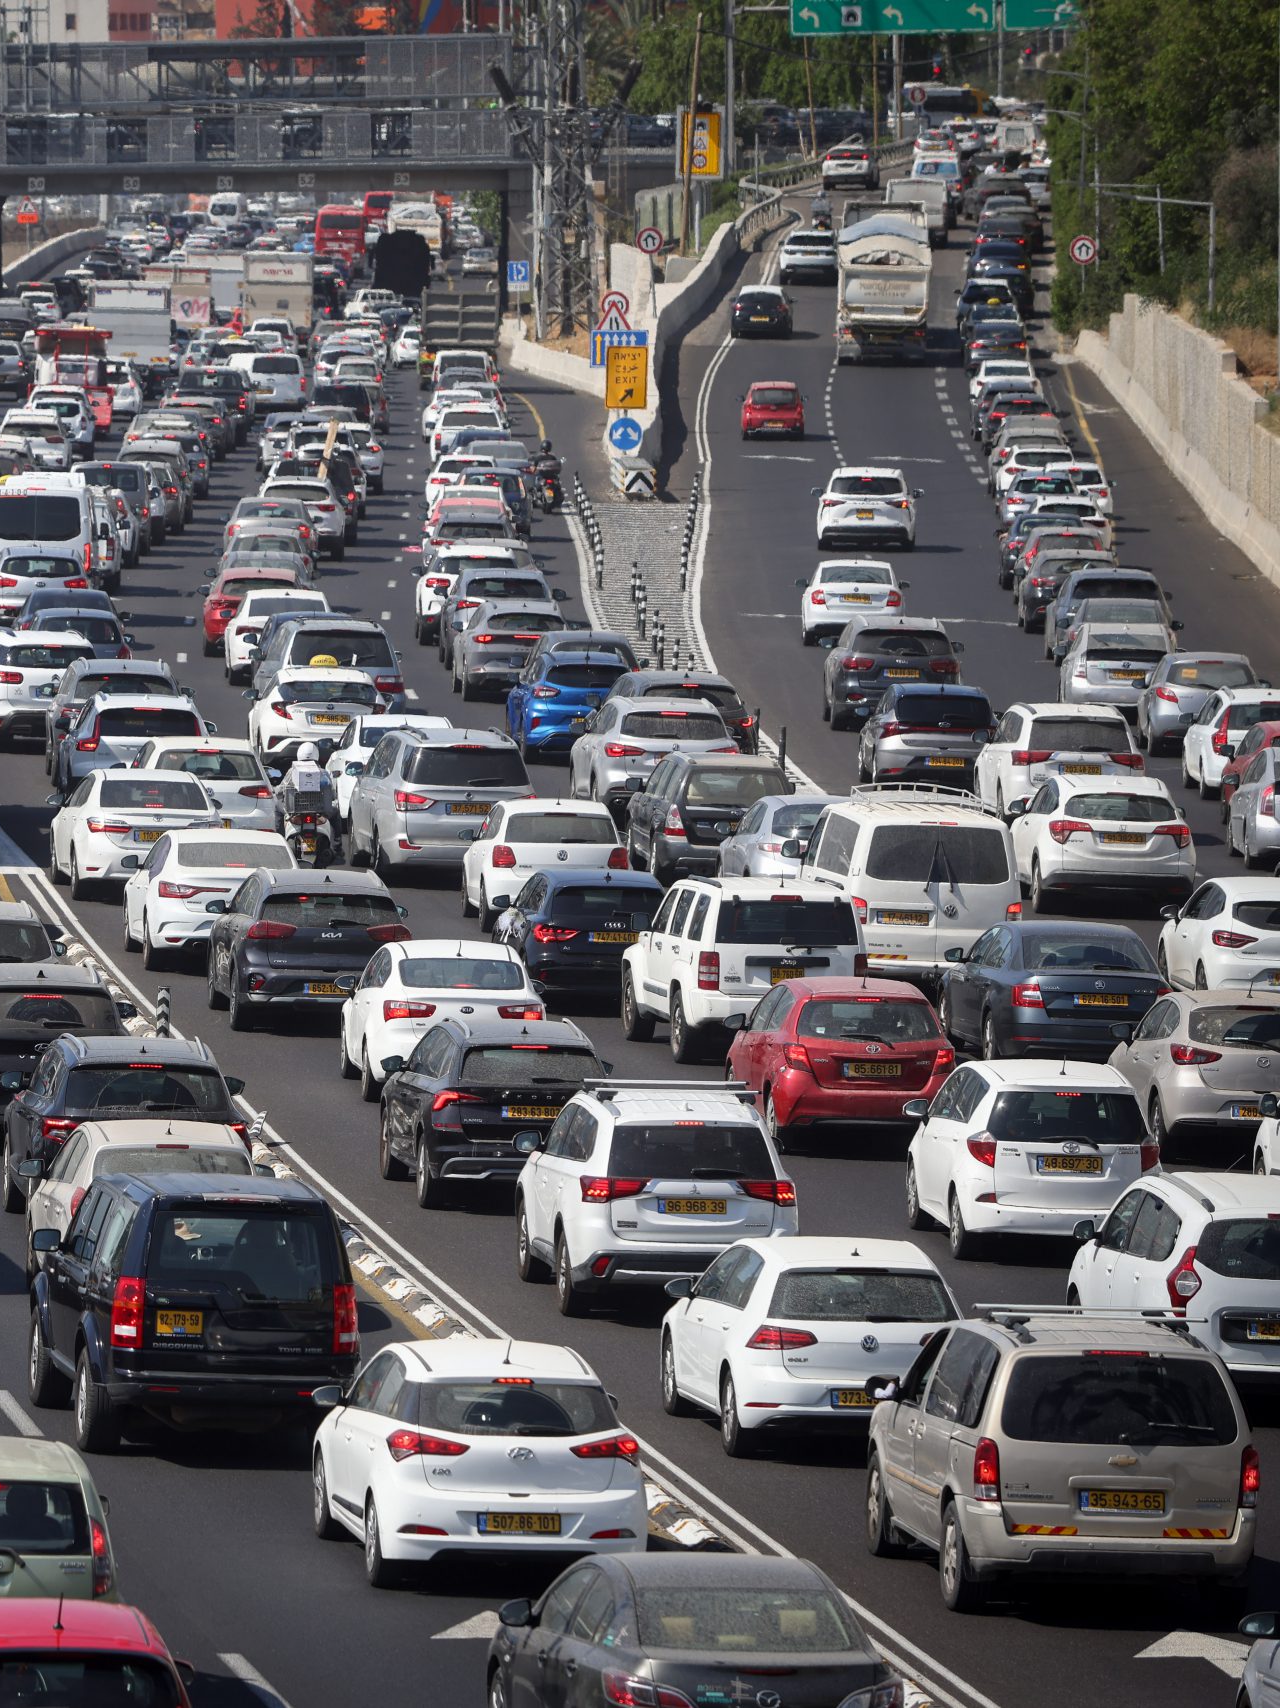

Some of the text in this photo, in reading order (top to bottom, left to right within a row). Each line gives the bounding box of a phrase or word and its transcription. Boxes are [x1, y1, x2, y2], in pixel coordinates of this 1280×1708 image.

[613, 352, 640, 361] יציאה
[615, 376, 638, 384] EXIT
[152, 1342, 205, 1350] DISCOVERY
